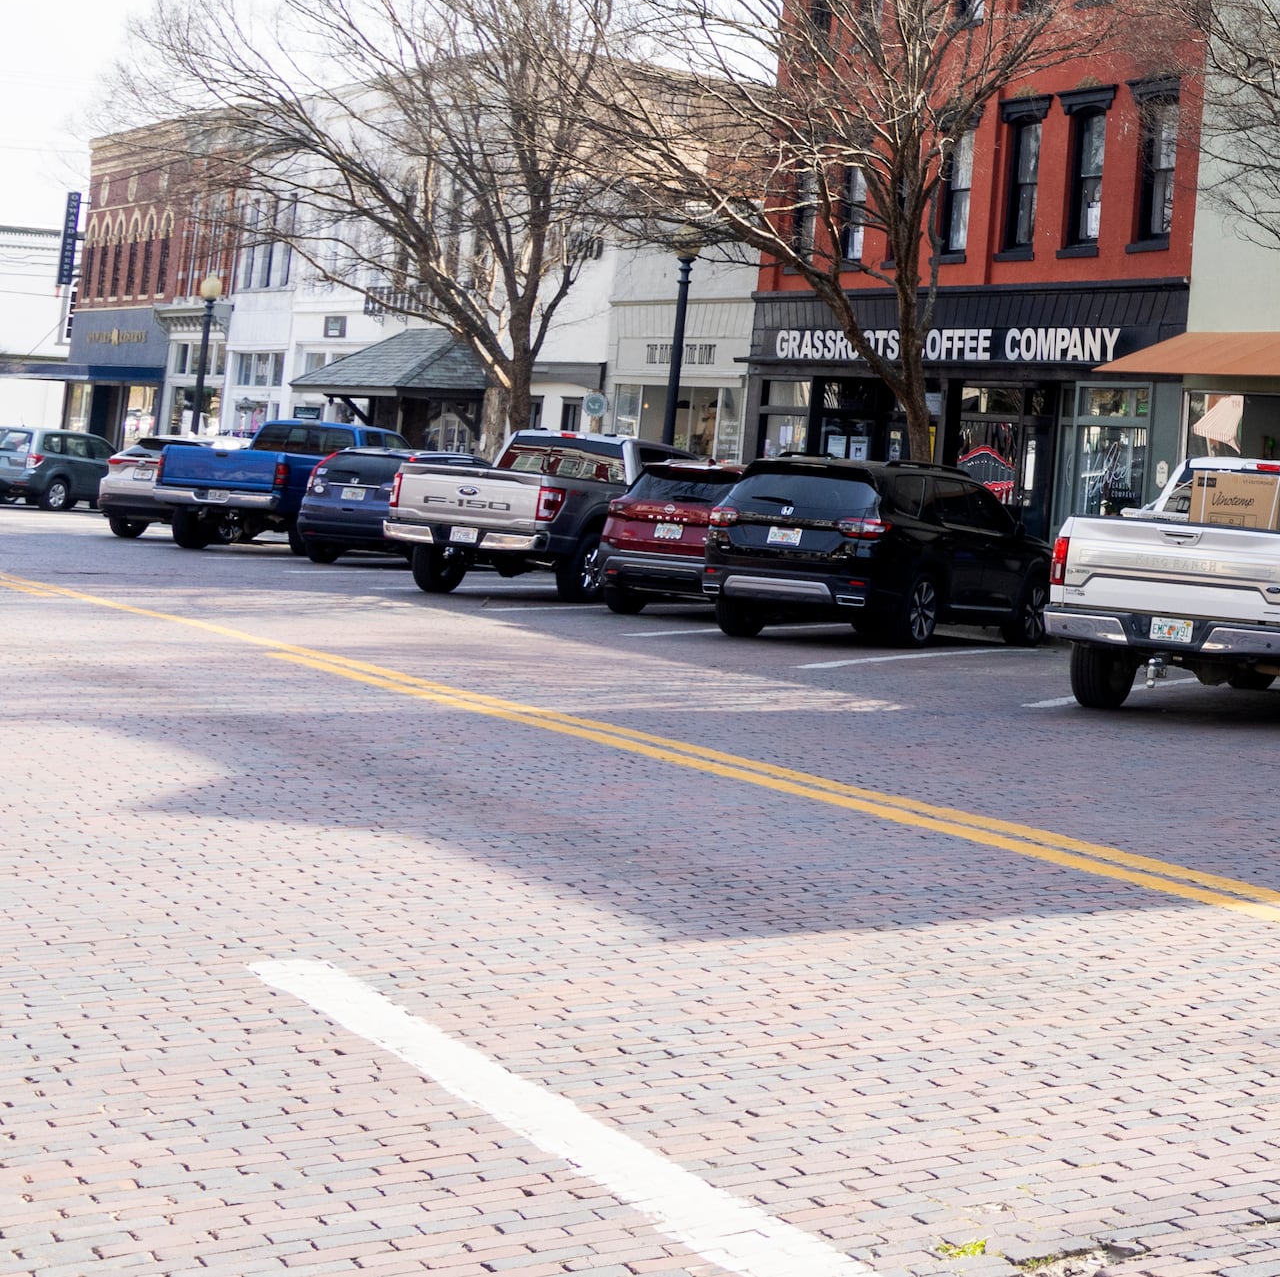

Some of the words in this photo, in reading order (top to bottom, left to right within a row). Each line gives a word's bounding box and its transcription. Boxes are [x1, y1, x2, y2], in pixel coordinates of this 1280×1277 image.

[921, 328, 992, 361] OFFEE
[1005, 327, 1121, 362] COMPANY
[423, 495, 511, 511] F-150
[1211, 491, 1256, 508] Vinotemp
[1135, 553, 1169, 566] KING
[1172, 558, 1217, 573] RANCH
